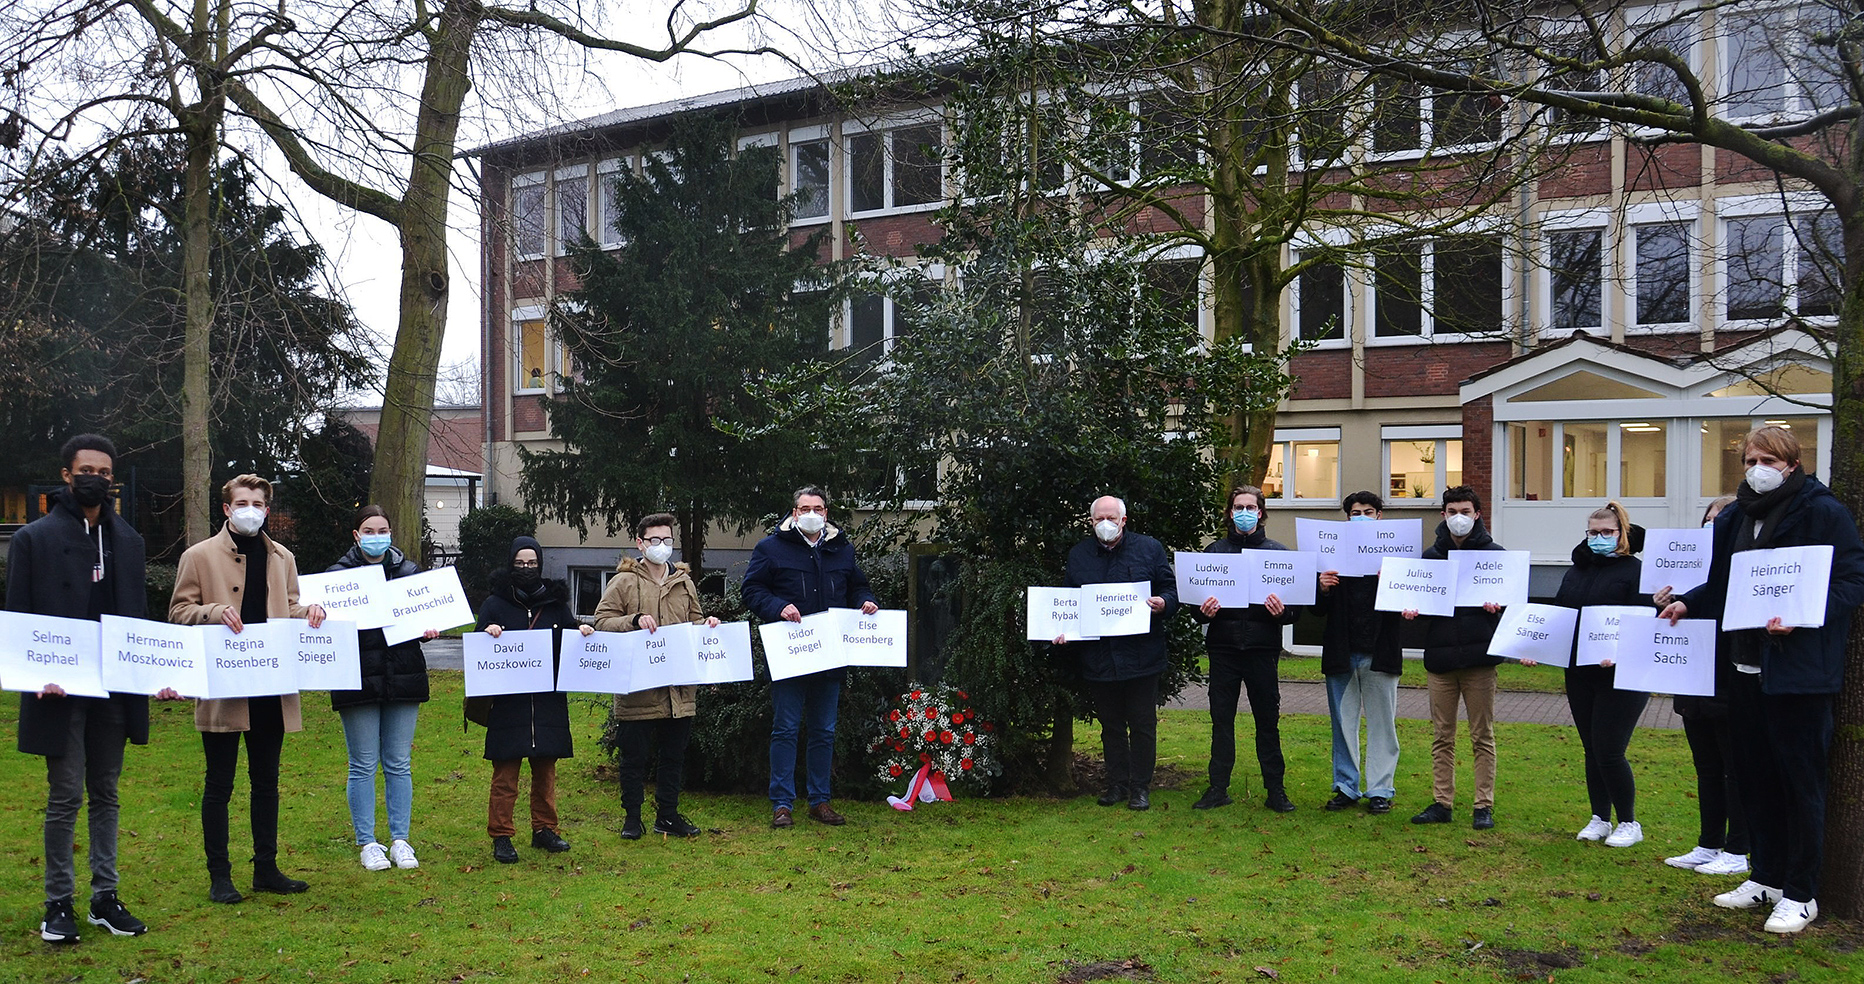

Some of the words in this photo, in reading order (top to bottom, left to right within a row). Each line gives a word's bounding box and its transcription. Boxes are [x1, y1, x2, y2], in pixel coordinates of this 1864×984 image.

[1318, 530, 1338, 541] Erna
[1376, 530, 1395, 539] Imo
[1320, 544, 1336, 554] Loé
[1357, 543, 1414, 554] Moszkowicz
[1668, 540, 1697, 552] Chana
[1195, 563, 1229, 575] Ludwig
[1264, 560, 1293, 571] Emma
[1474, 561, 1504, 571] Adele
[1655, 557, 1703, 569] Obarzanski
[1750, 561, 1802, 578] Heinrich
[1261, 573, 1295, 586] Spiegel
[1406, 568, 1433, 579] Julius
[1472, 575, 1504, 585] Simon
[324, 581, 360, 594] Frieda
[1188, 576, 1236, 587] Kaufmann
[1388, 580, 1447, 596] Loewenberg
[406, 585, 430, 598] Kurt
[1752, 583, 1794, 598] Sänger
[322, 594, 369, 609] Herzfeld
[1053, 597, 1078, 607] Berta
[1095, 593, 1138, 603] Henriette
[392, 592, 455, 618] Braunschild
[1100, 605, 1133, 617] Spiegel
[1051, 610, 1079, 622] Rybak
[1526, 613, 1545, 625] Else
[858, 620, 878, 631] Else
[32, 629, 72, 646] Selma
[299, 632, 333, 645] Emma
[787, 628, 815, 641] Isidor
[842, 633, 894, 647] Rosenberg
[1515, 626, 1550, 641] Sänger
[1653, 632, 1689, 646] Emma
[126, 632, 184, 650] Hermann
[224, 638, 265, 653] Regina
[584, 642, 608, 653] Edith
[645, 637, 666, 650] Paul
[702, 636, 719, 646] Leo
[787, 639, 822, 656] Spiegel
[493, 642, 524, 654] David
[26, 649, 79, 666] Raphael
[118, 650, 194, 669] Moszkowicz
[215, 655, 280, 669] Rosenberg
[297, 650, 336, 665] Spiegel
[648, 652, 667, 665] Loé
[697, 649, 727, 663] Rybak
[1653, 651, 1688, 665] Sachs
[477, 657, 542, 671] Moszkowicz
[578, 657, 612, 671] Spiegel
